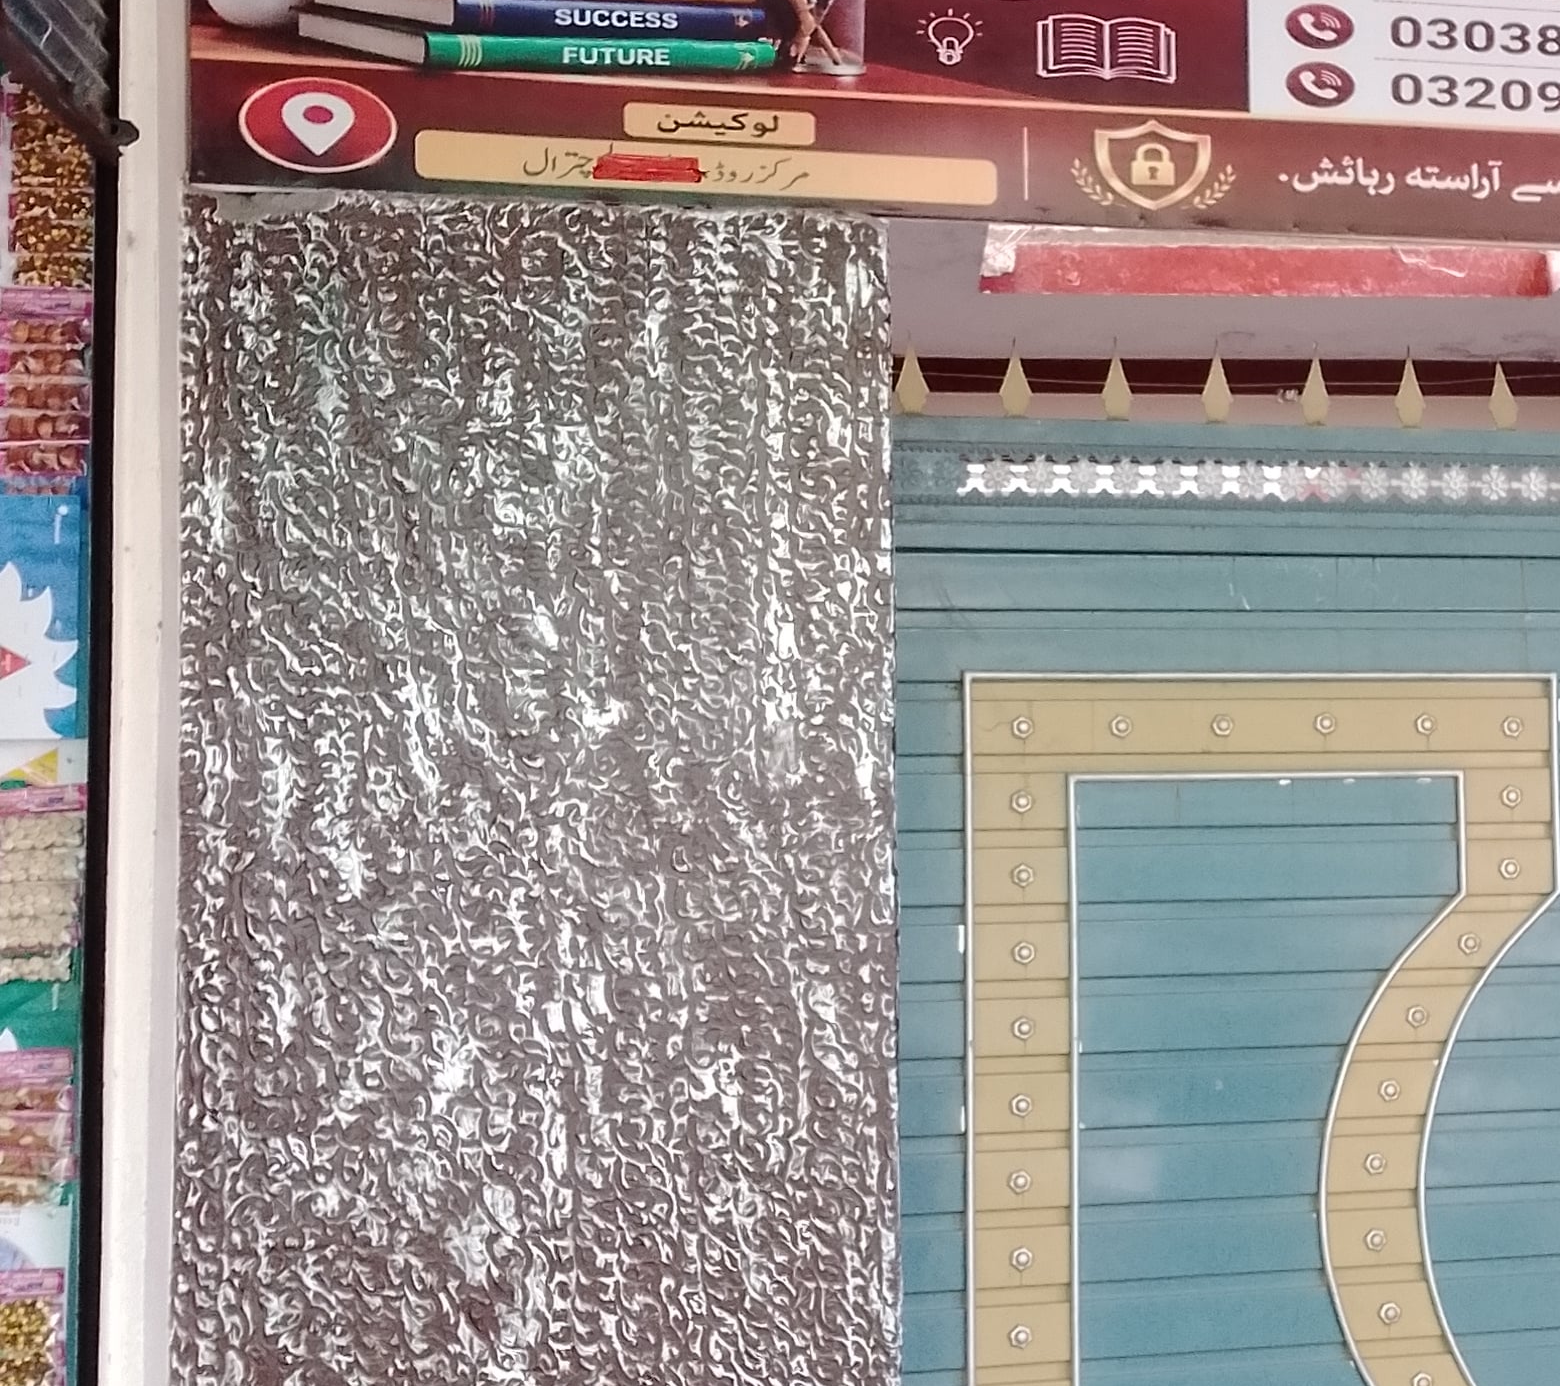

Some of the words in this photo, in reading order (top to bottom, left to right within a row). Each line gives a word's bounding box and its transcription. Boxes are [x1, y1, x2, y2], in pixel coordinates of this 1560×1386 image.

[553, 6, 679, 32] SUCCESS
[561, 42, 672, 68] FUTURE
[656, 110, 780, 135] لوکیشن
[1405, 158, 1503, 199] آراستہ
